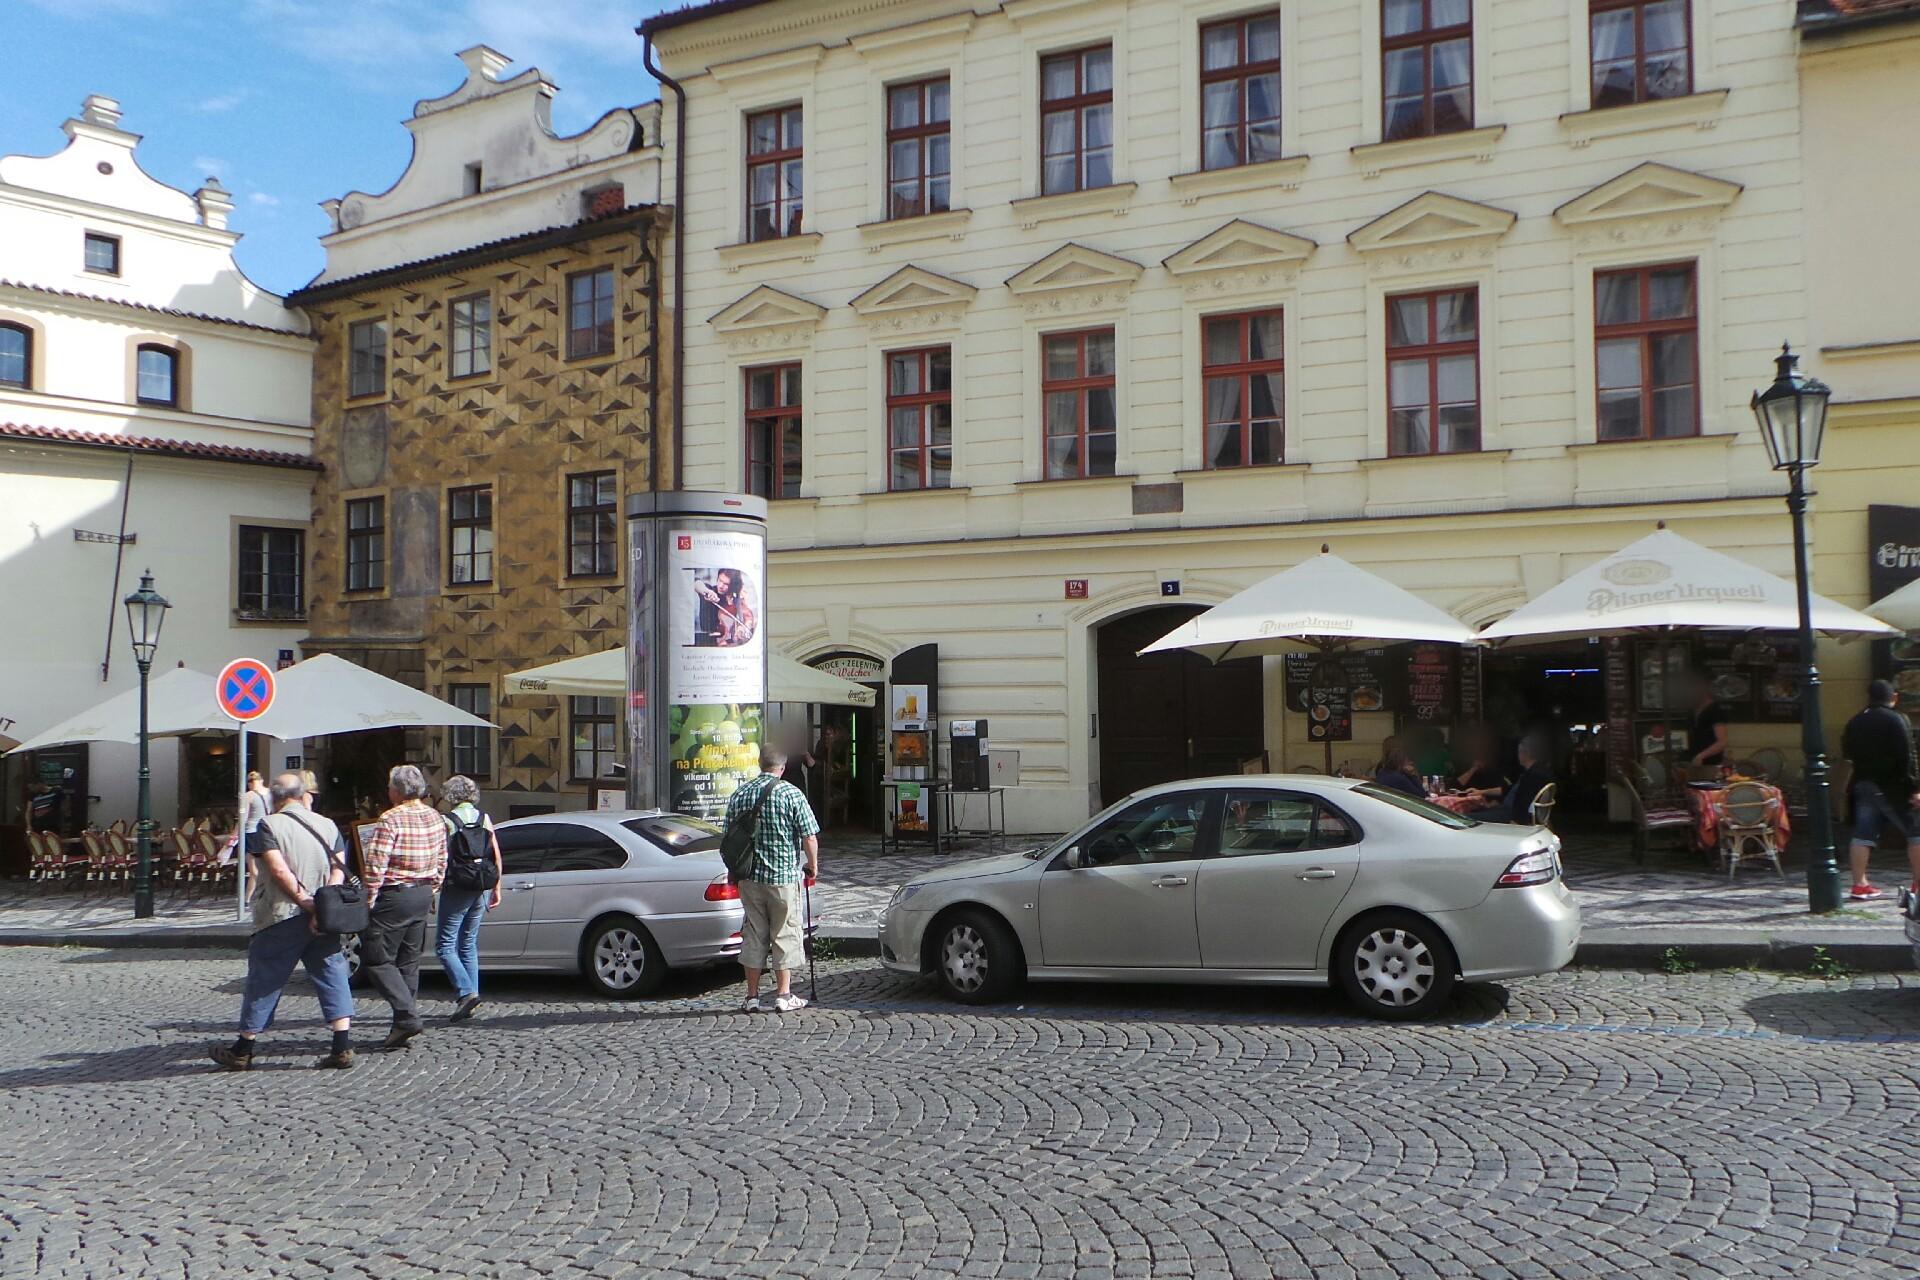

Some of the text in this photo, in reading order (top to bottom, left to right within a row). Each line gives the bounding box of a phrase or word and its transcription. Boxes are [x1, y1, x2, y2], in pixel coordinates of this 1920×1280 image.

[1069, 581, 1083, 590] 174
[1167, 584, 1173, 593] 3
[1585, 583, 1765, 617] Pilsner Urquell
[676, 761, 690, 769] na
[694, 782, 705, 791] od
[707, 782, 716, 790] 11
